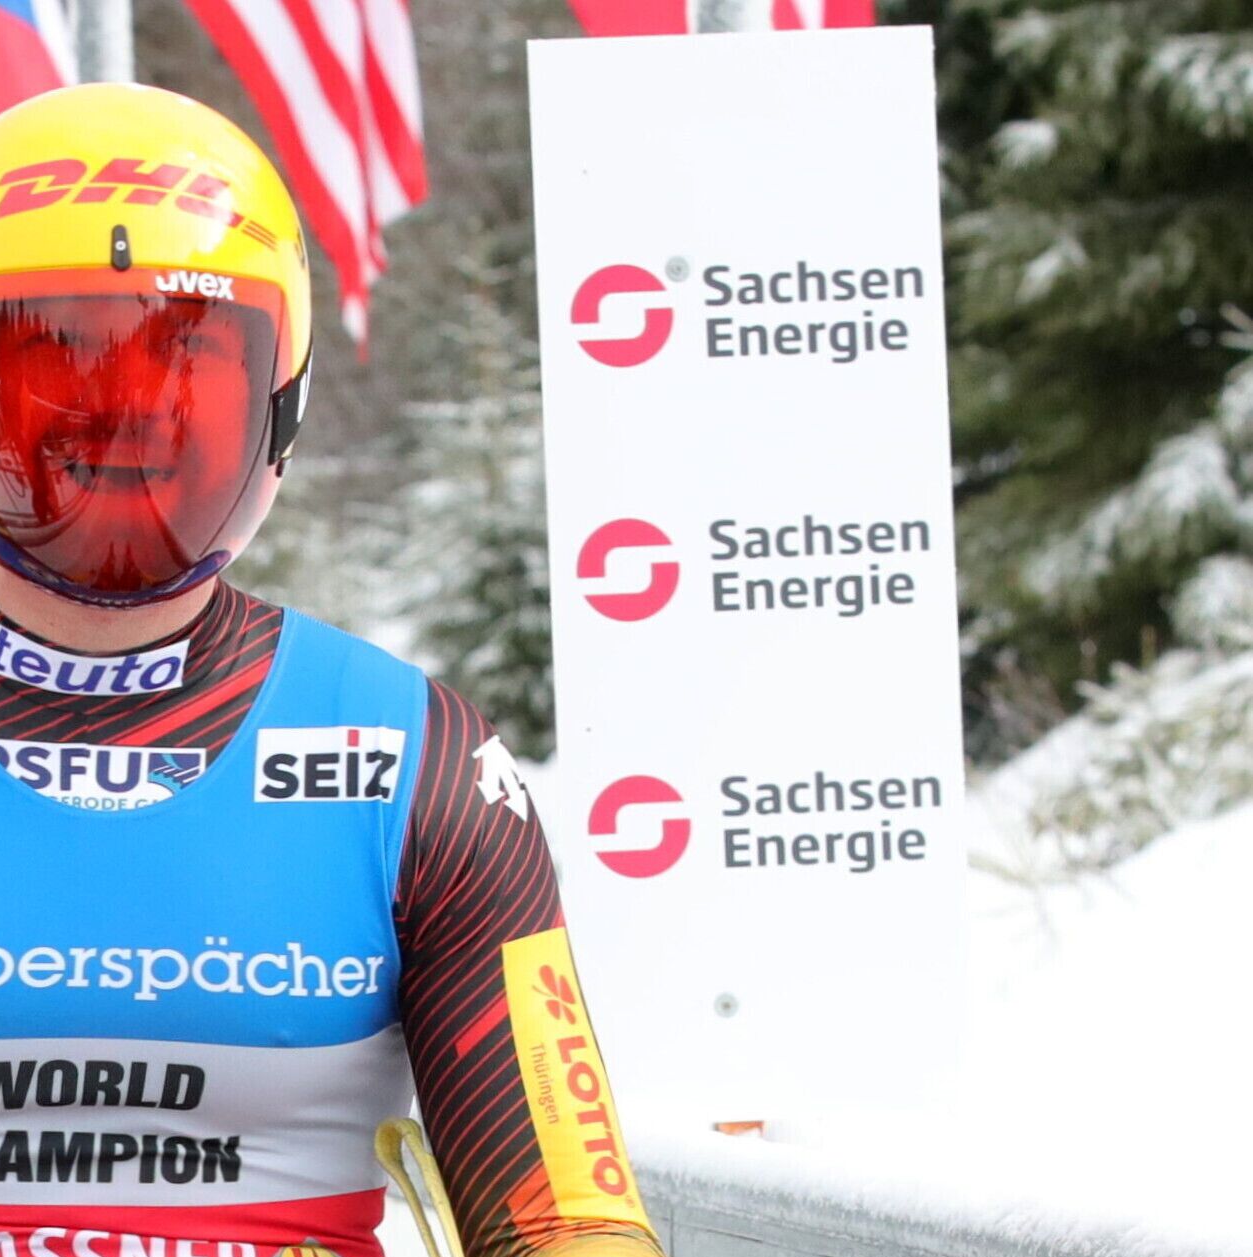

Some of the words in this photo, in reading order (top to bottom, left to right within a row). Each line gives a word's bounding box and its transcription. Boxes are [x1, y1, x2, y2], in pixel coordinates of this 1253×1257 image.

[156, 271, 234, 300] uvex
[702, 261, 925, 306] Sachsen
[705, 310, 910, 364] Energie
[709, 515, 931, 560] Sachsen
[711, 564, 915, 618] Energie
[719, 771, 942, 817] Sachsen
[723, 820, 926, 874] Energie
[529, 1042, 559, 1125] Thüringen
[556, 1035, 628, 1196] LOTTO
